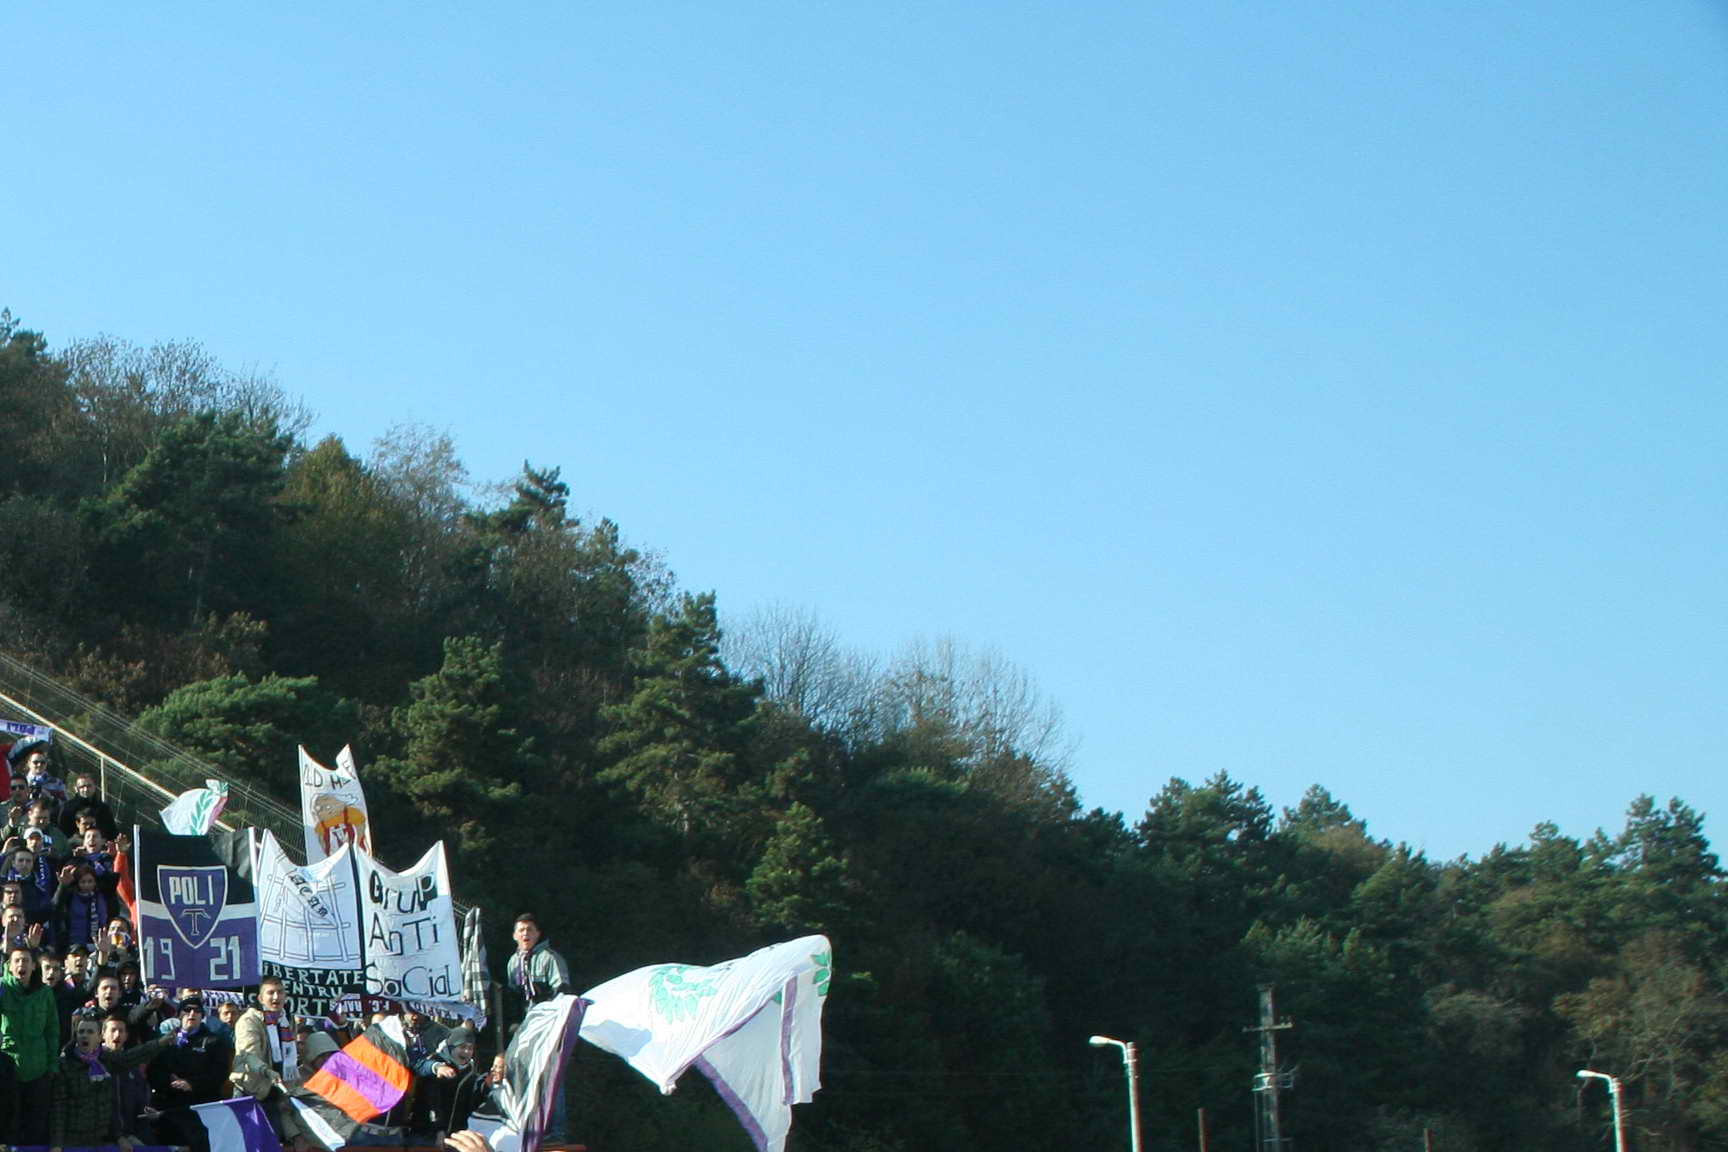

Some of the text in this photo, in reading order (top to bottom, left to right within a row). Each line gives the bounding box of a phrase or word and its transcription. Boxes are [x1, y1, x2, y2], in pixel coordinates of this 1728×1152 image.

[169, 875, 215, 906] POLI
[143, 935, 241, 981] 19 21
